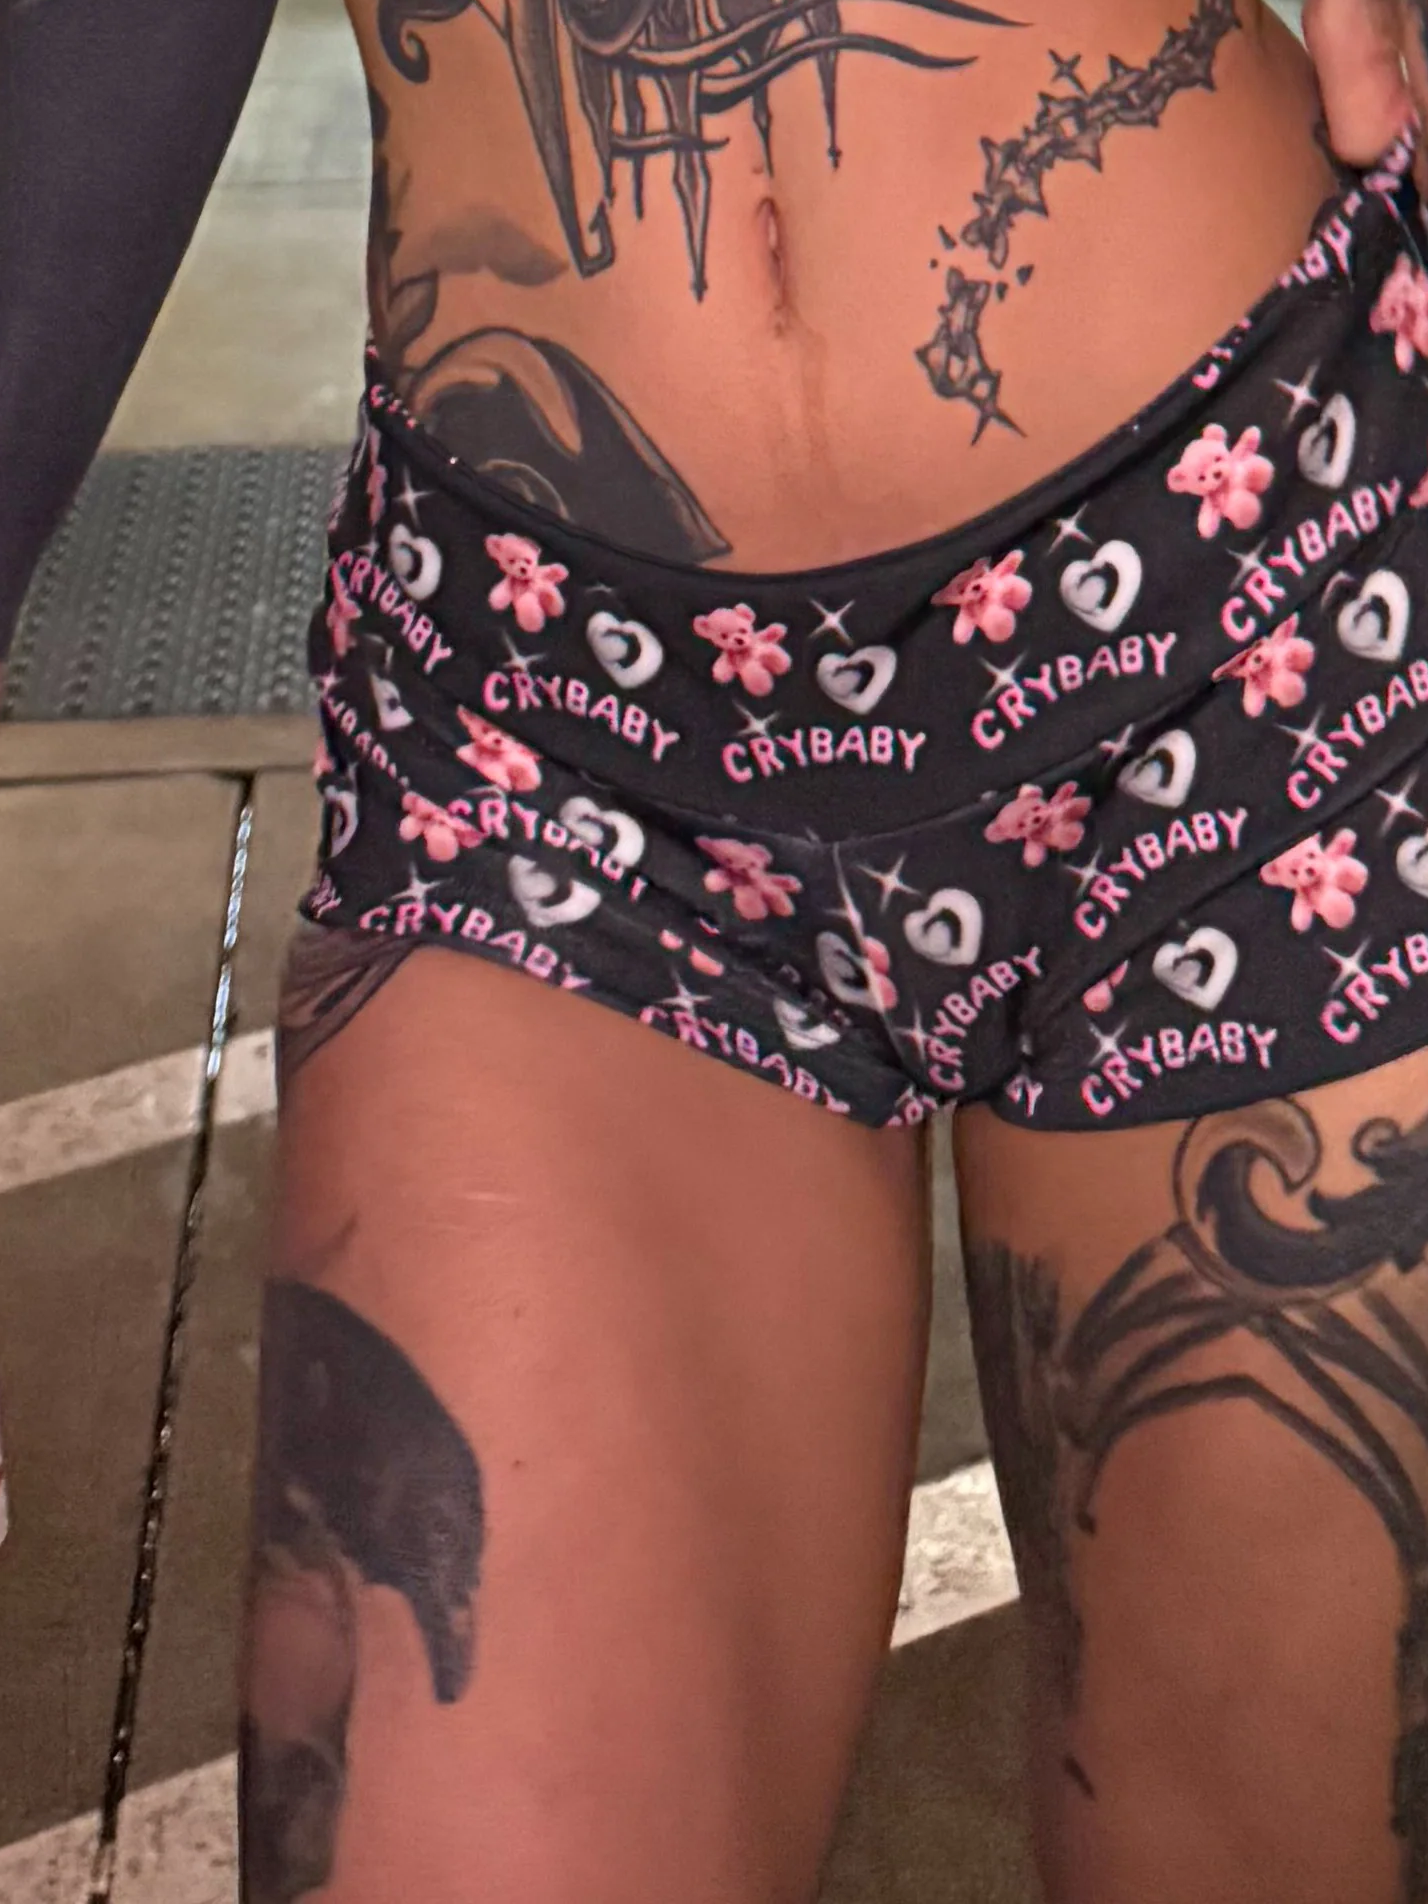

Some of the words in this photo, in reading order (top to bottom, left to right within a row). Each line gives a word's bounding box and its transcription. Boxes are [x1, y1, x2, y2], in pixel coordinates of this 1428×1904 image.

[331, 550, 453, 674] CRYBABY
[1220, 479, 1402, 642] CRYBABY
[483, 672, 679, 762] CRYBABY
[973, 632, 1177, 749] CRYBABY
[722, 726, 925, 782] CRYBABY
[1074, 808, 1248, 939] CRYBABY
[929, 947, 1042, 1092] CRYBABY
[1083, 1022, 1277, 1116] CRYBABY
